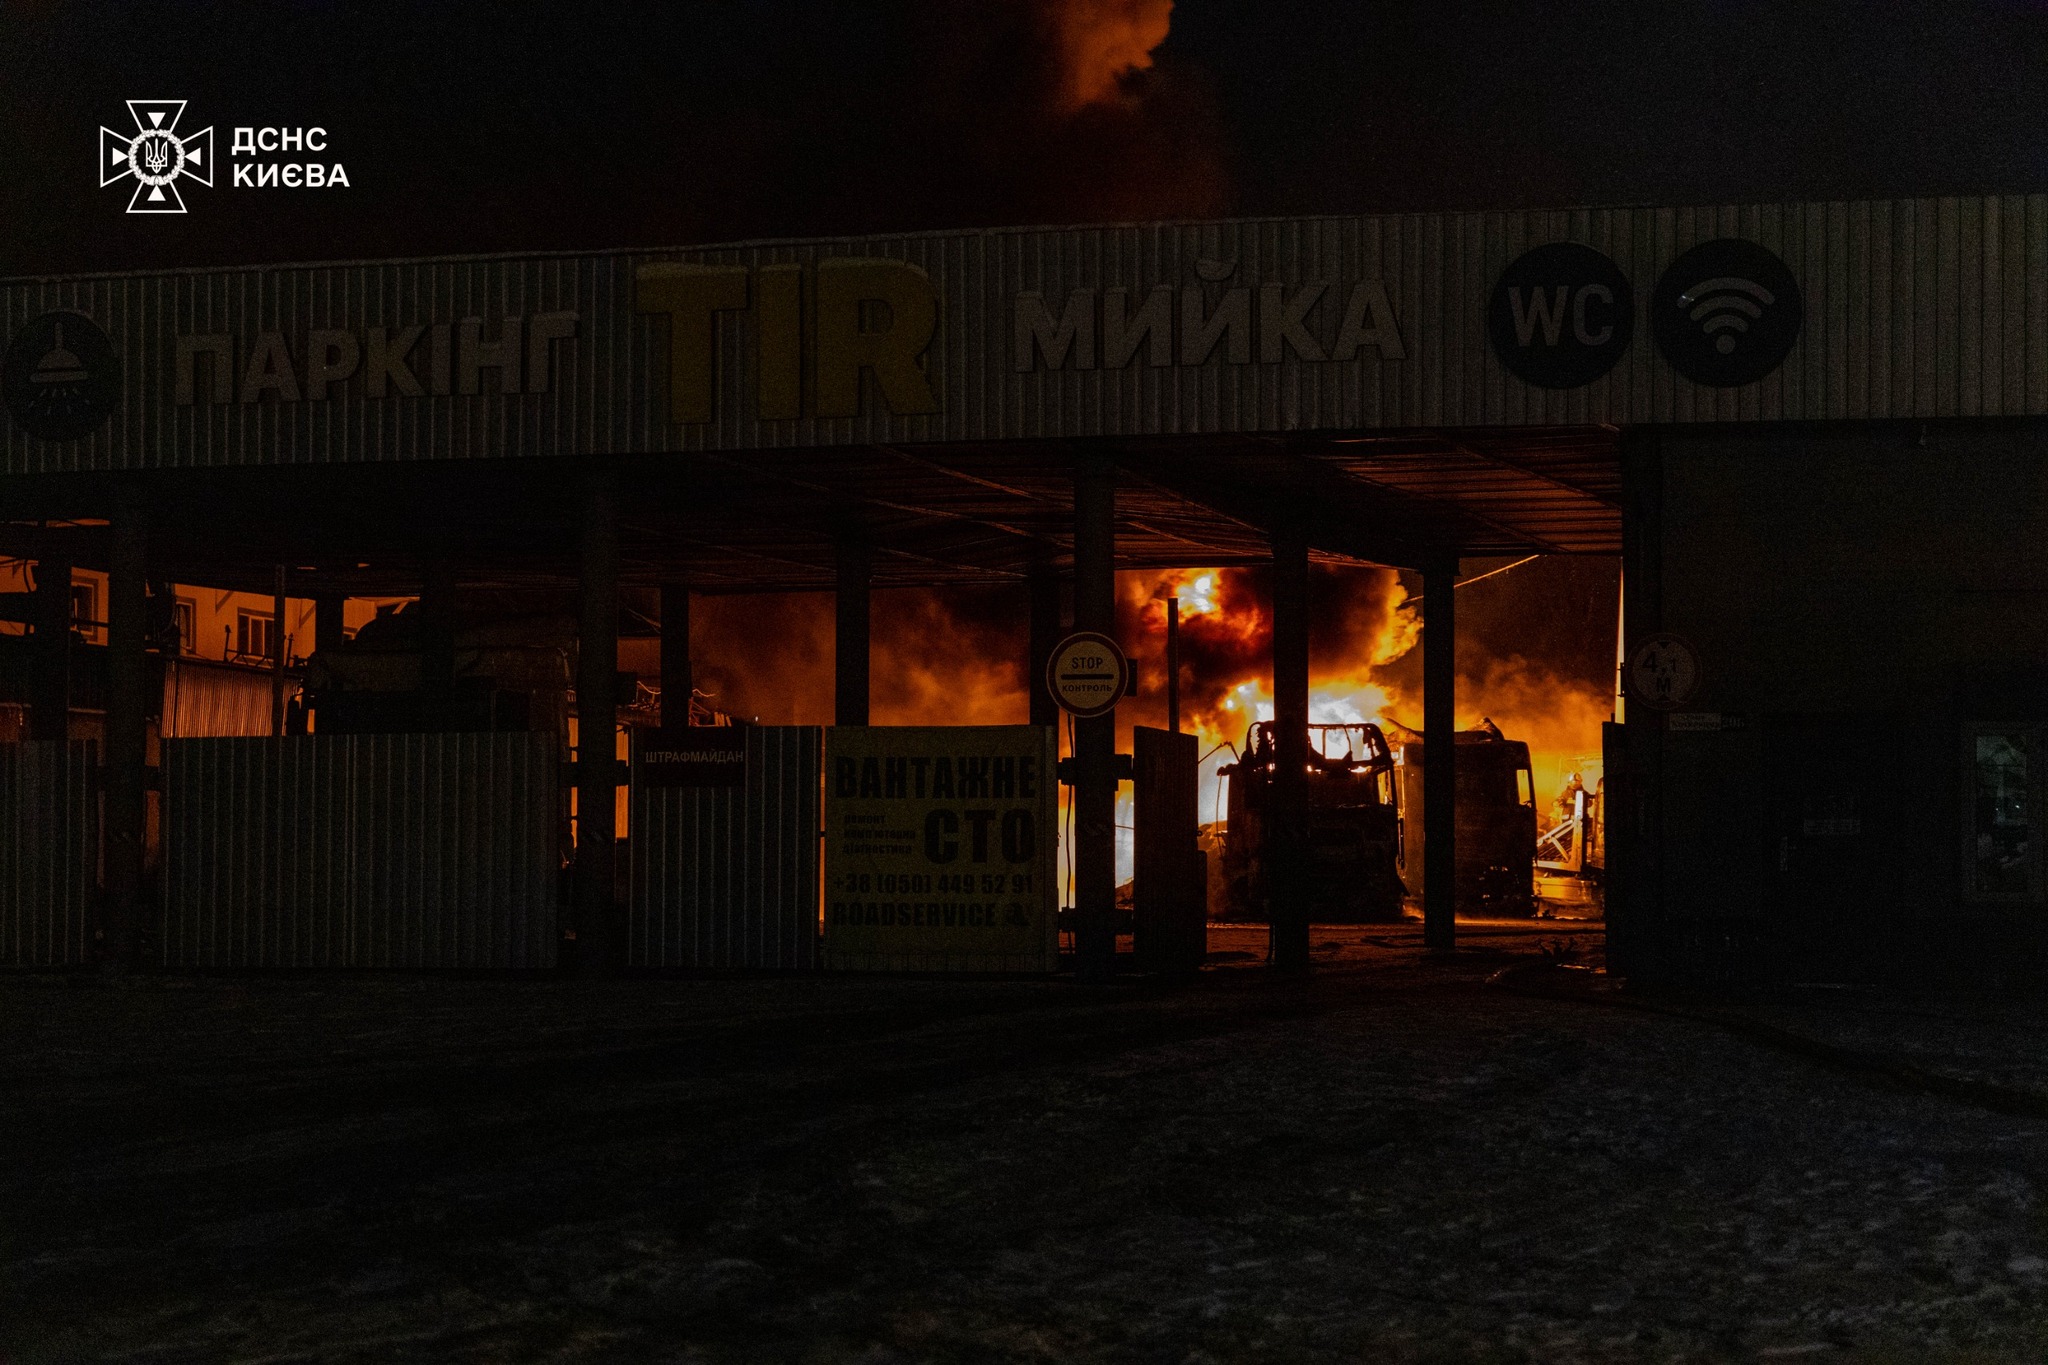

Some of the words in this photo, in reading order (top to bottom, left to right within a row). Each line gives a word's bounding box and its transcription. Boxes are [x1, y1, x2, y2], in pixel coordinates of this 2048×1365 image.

[1015, 258, 1408, 373] МИЙКА
[1507, 283, 1614, 347] WC
[175, 312, 580, 405] ПАРКІНГ
[634, 256, 944, 425] TIR
[1071, 657, 1103, 669] STOP
[1062, 684, 1112, 692] КОНТРОЛЬ
[645, 749, 744, 764] ШТРАФМАЙДАН
[835, 756, 1036, 798] ВАНТАЖНЕ
[924, 808, 1036, 864] СТО
[833, 874, 871, 893] +38
[877, 874, 931, 893] (050)
[937, 874, 975, 893] 449
[982, 874, 1005, 893] 52
[1012, 874, 1034, 893] 91
[832, 903, 996, 926] ROADSERVICE
